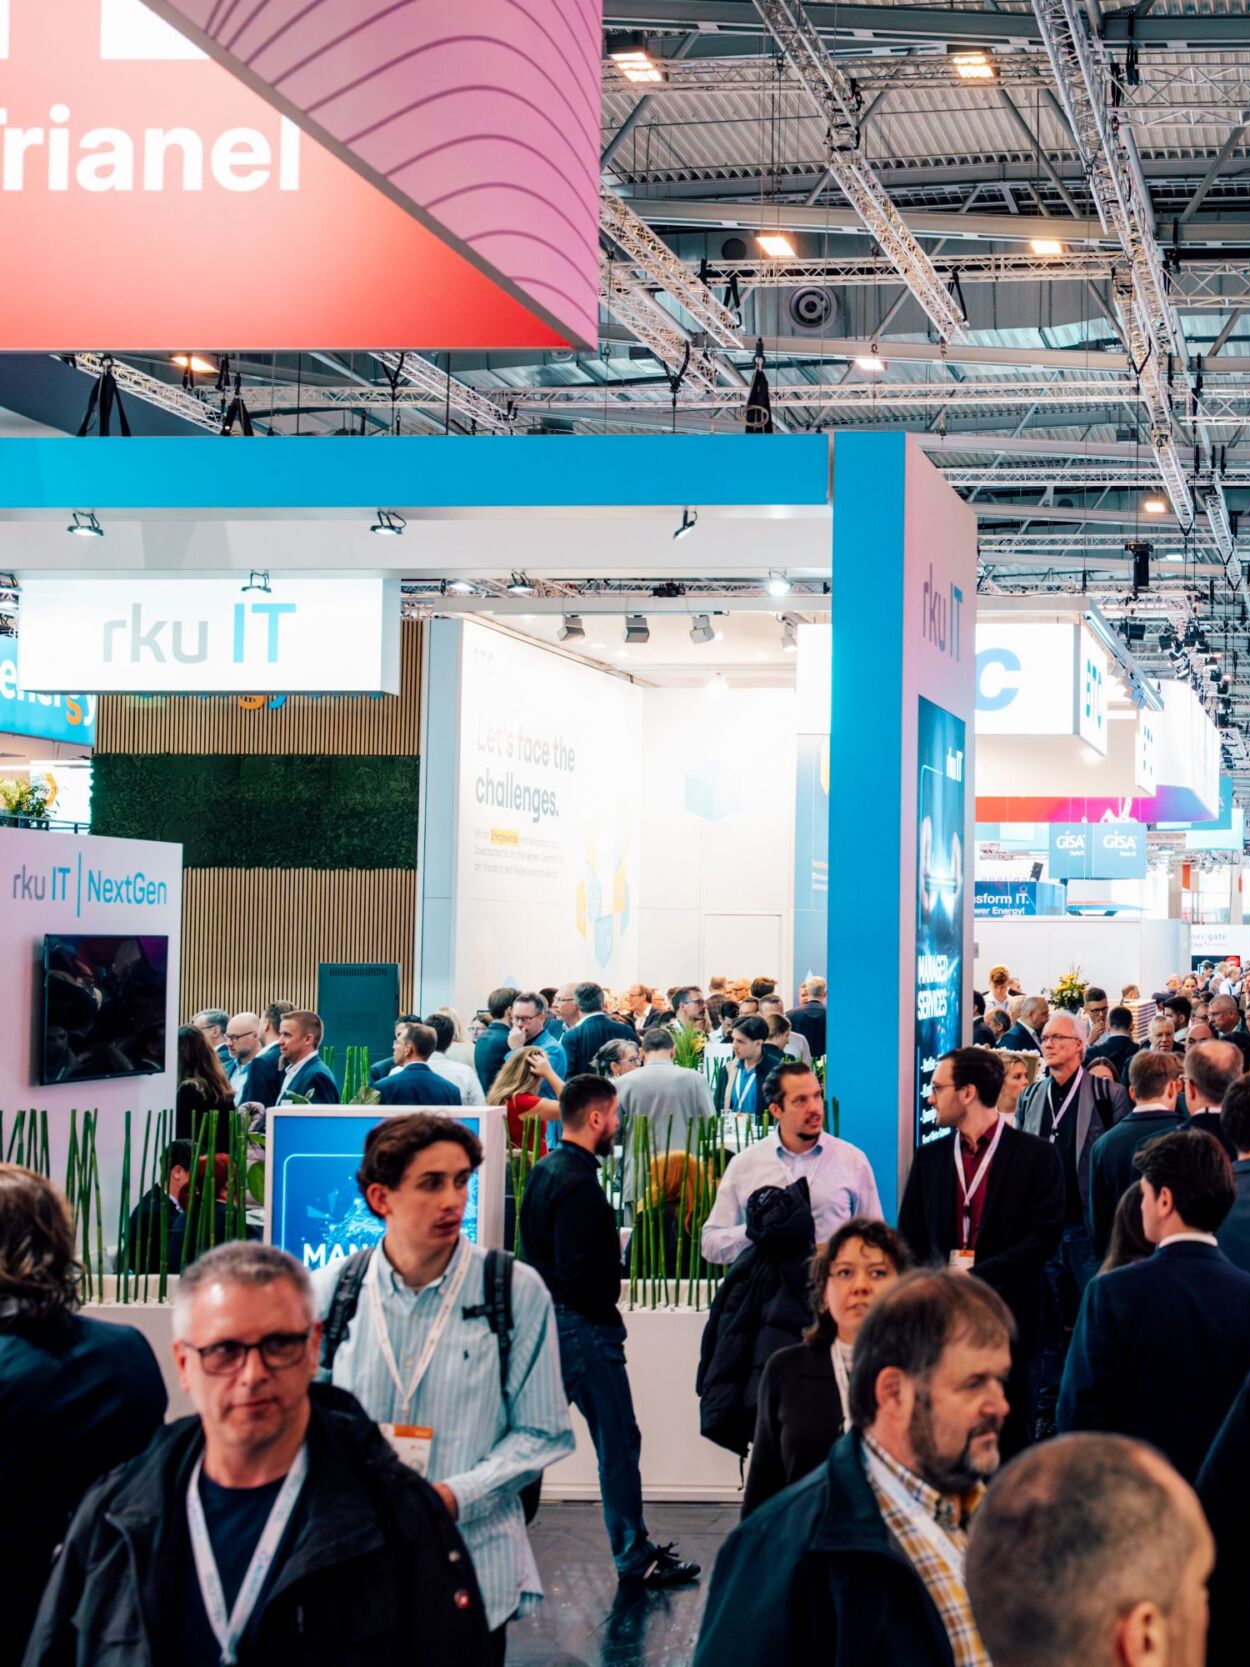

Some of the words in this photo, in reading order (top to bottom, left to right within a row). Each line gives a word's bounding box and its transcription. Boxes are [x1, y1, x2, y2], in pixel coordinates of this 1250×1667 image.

[0, 103, 301, 192] rianel
[102, 603, 209, 664] rku
[233, 603, 296, 663] IT
[922, 562, 946, 652] rku
[949, 581, 963, 662] IT
[517, 724, 550, 767] face
[553, 735, 576, 773] the
[475, 766, 559, 823] challenges.
[13, 864, 46, 901] rku
[52, 866, 71, 901] IT
[87, 869, 167, 905] NextGen
[973, 893, 1012, 904] sform
